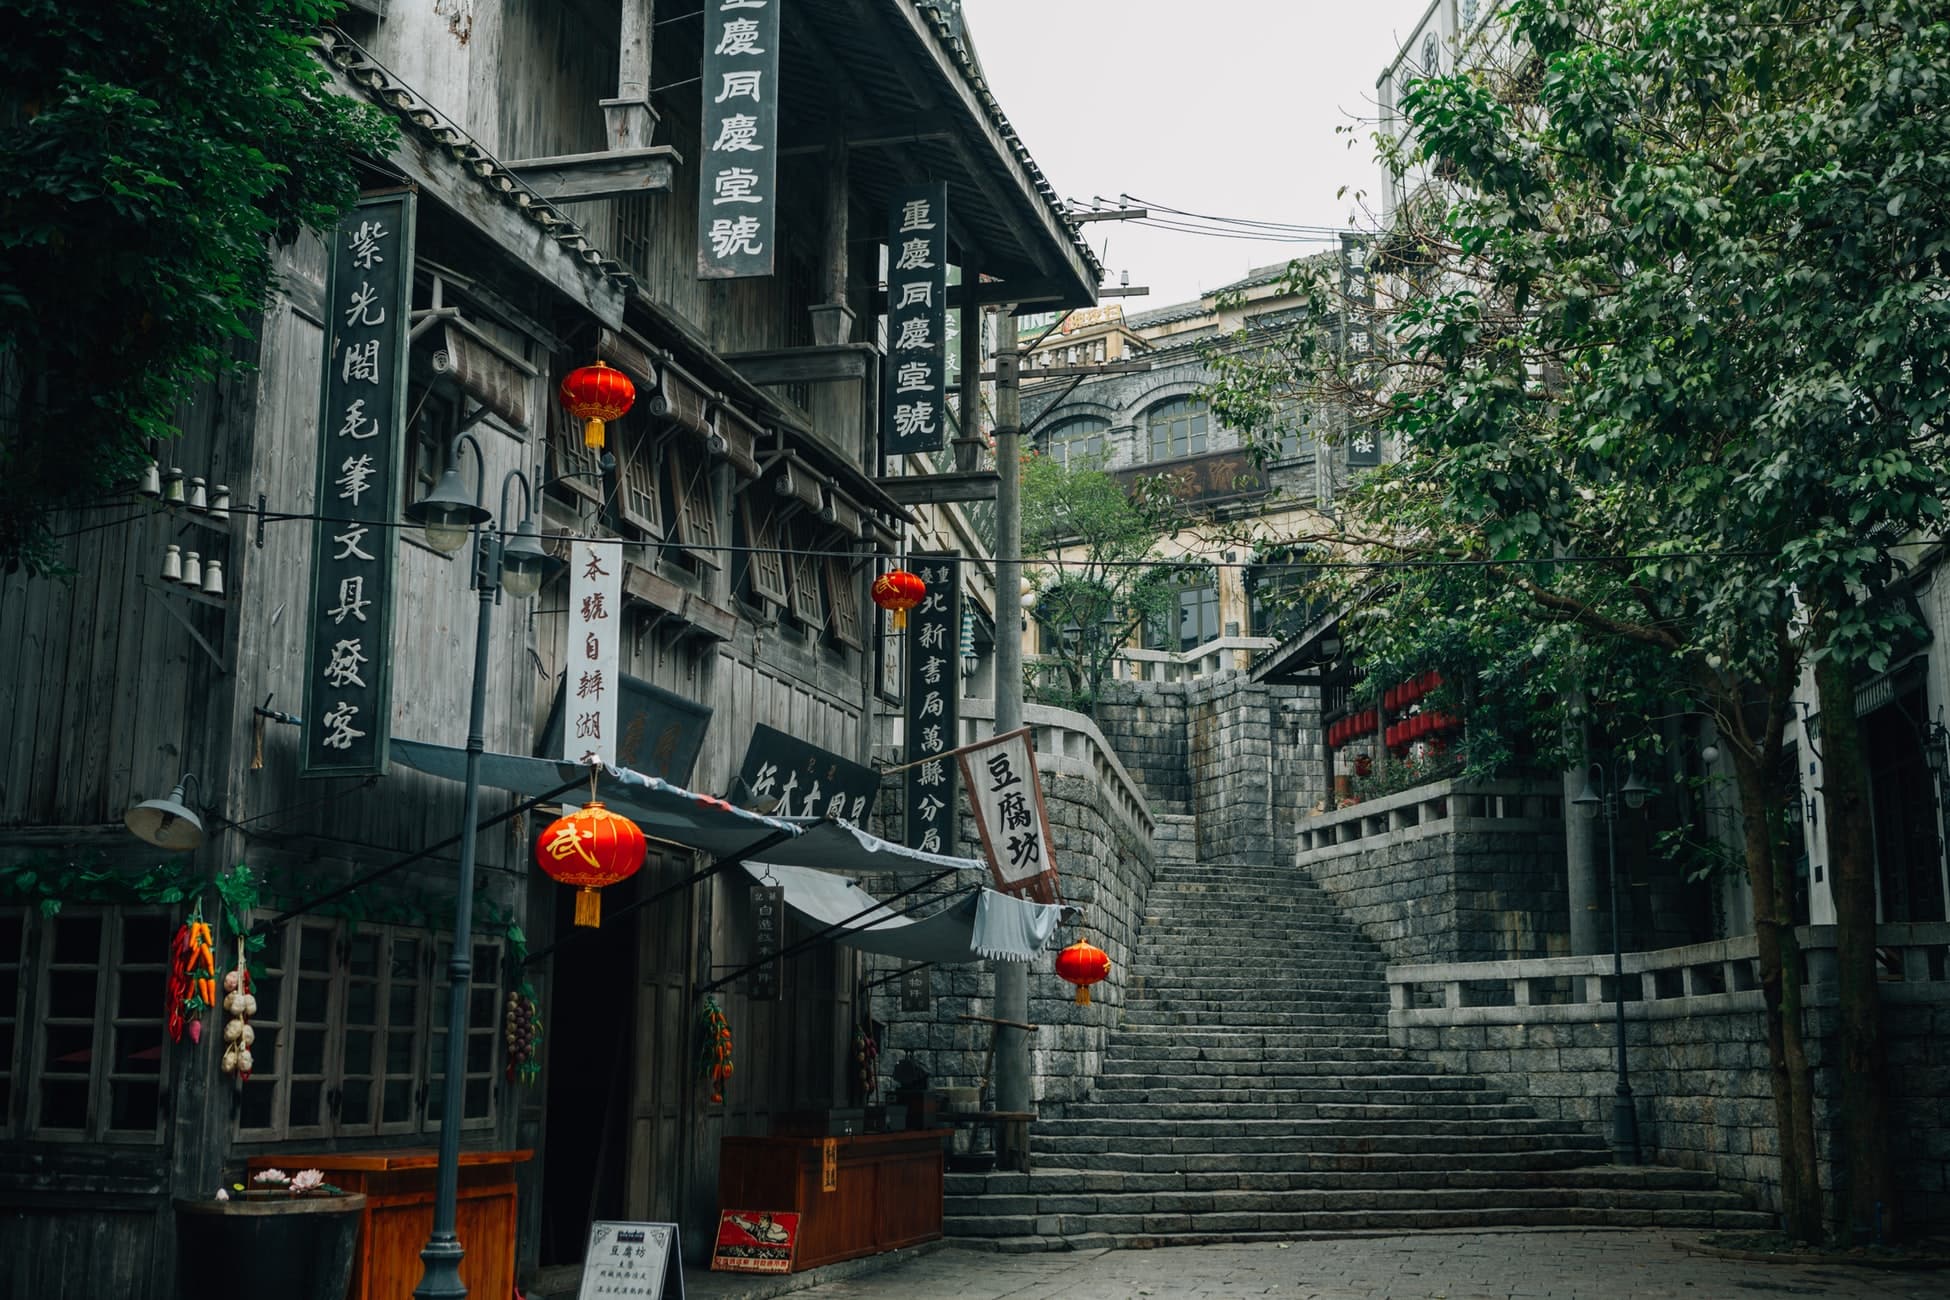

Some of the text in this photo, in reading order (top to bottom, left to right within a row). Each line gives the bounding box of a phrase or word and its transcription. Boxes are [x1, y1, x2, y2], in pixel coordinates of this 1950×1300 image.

[893, 199, 936, 437] 重慶同慶堂號
[322, 221, 389, 750] 紫光閣毛筆文具發客
[917, 592, 947, 853] 北新書局萬縣分局
[987, 752, 1040, 869] 豆腐坊
